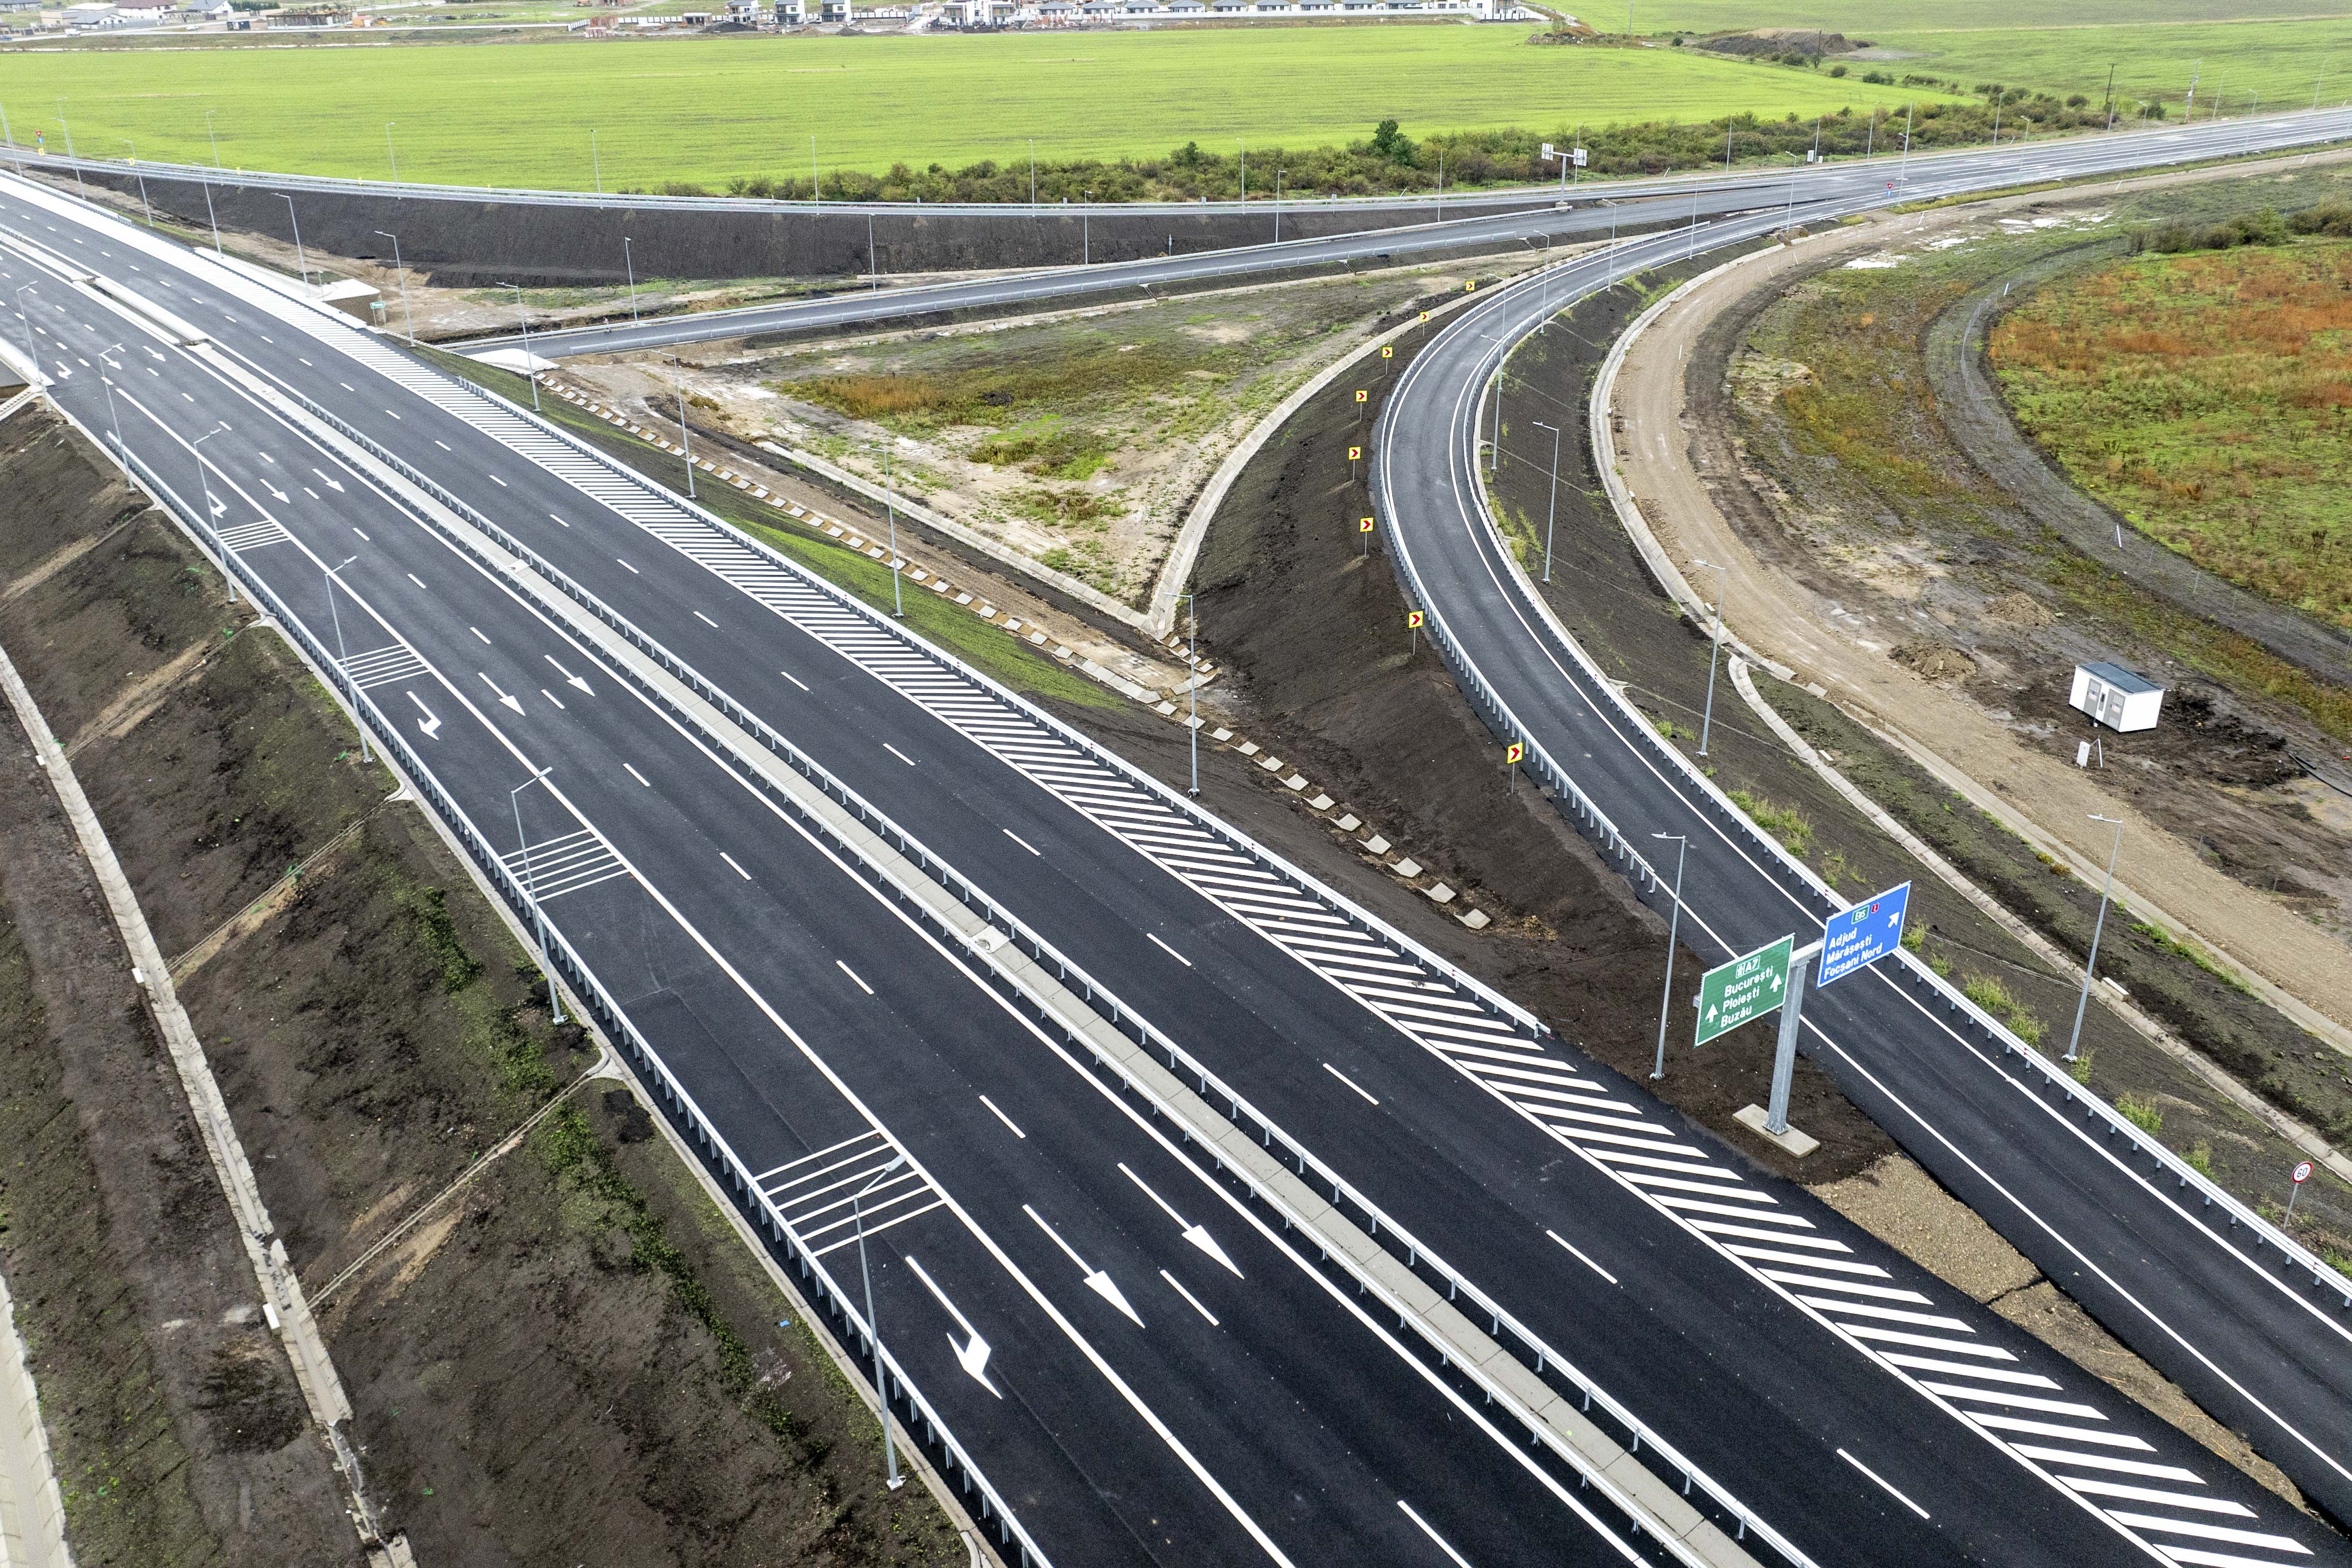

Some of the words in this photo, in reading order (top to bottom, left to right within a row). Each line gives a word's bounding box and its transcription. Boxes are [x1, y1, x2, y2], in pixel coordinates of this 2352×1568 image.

[1828, 927, 1857, 950] Adjud
[1745, 958, 1759, 972] A7
[1824, 953, 1860, 979] Focșani
[1861, 942, 1883, 962] Nord
[1724, 965, 1773, 997] București
[1723, 986, 1760, 1013] Ploiești
[1720, 1006, 1752, 1028] Buzău
[2296, 1167, 2308, 1177] 60
